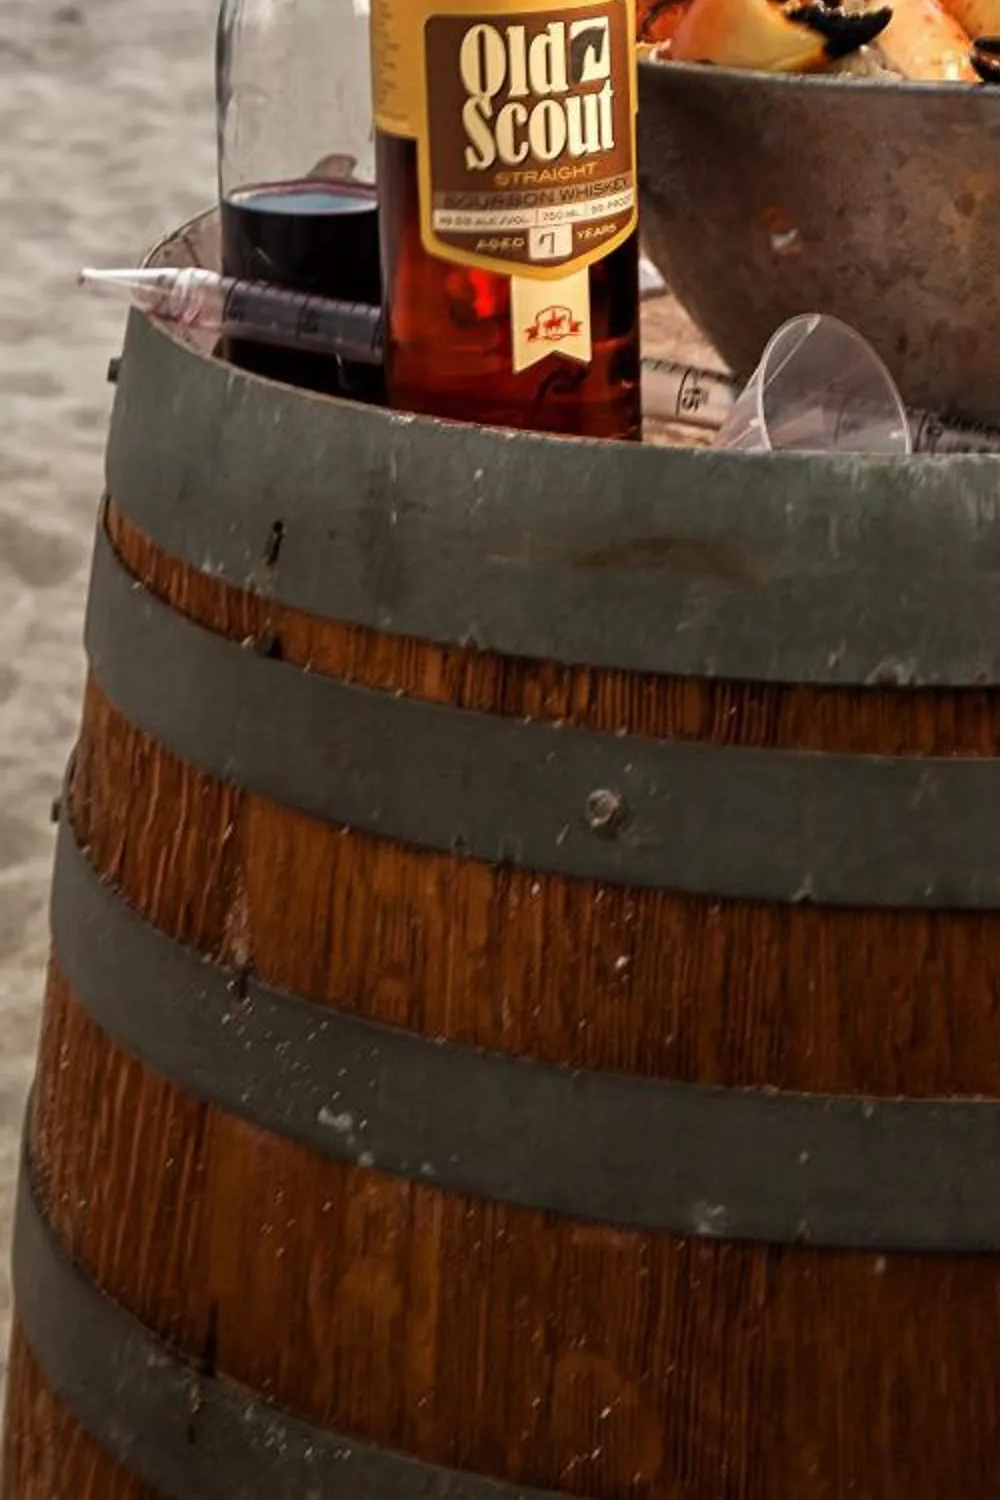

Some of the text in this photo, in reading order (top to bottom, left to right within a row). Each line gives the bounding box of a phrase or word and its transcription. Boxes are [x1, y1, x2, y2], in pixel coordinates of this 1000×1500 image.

[460, 21, 569, 98] Old
[462, 79, 615, 171] Scout
[495, 161, 599, 187] STRAIGHT
[538, 231, 555, 255] 7
